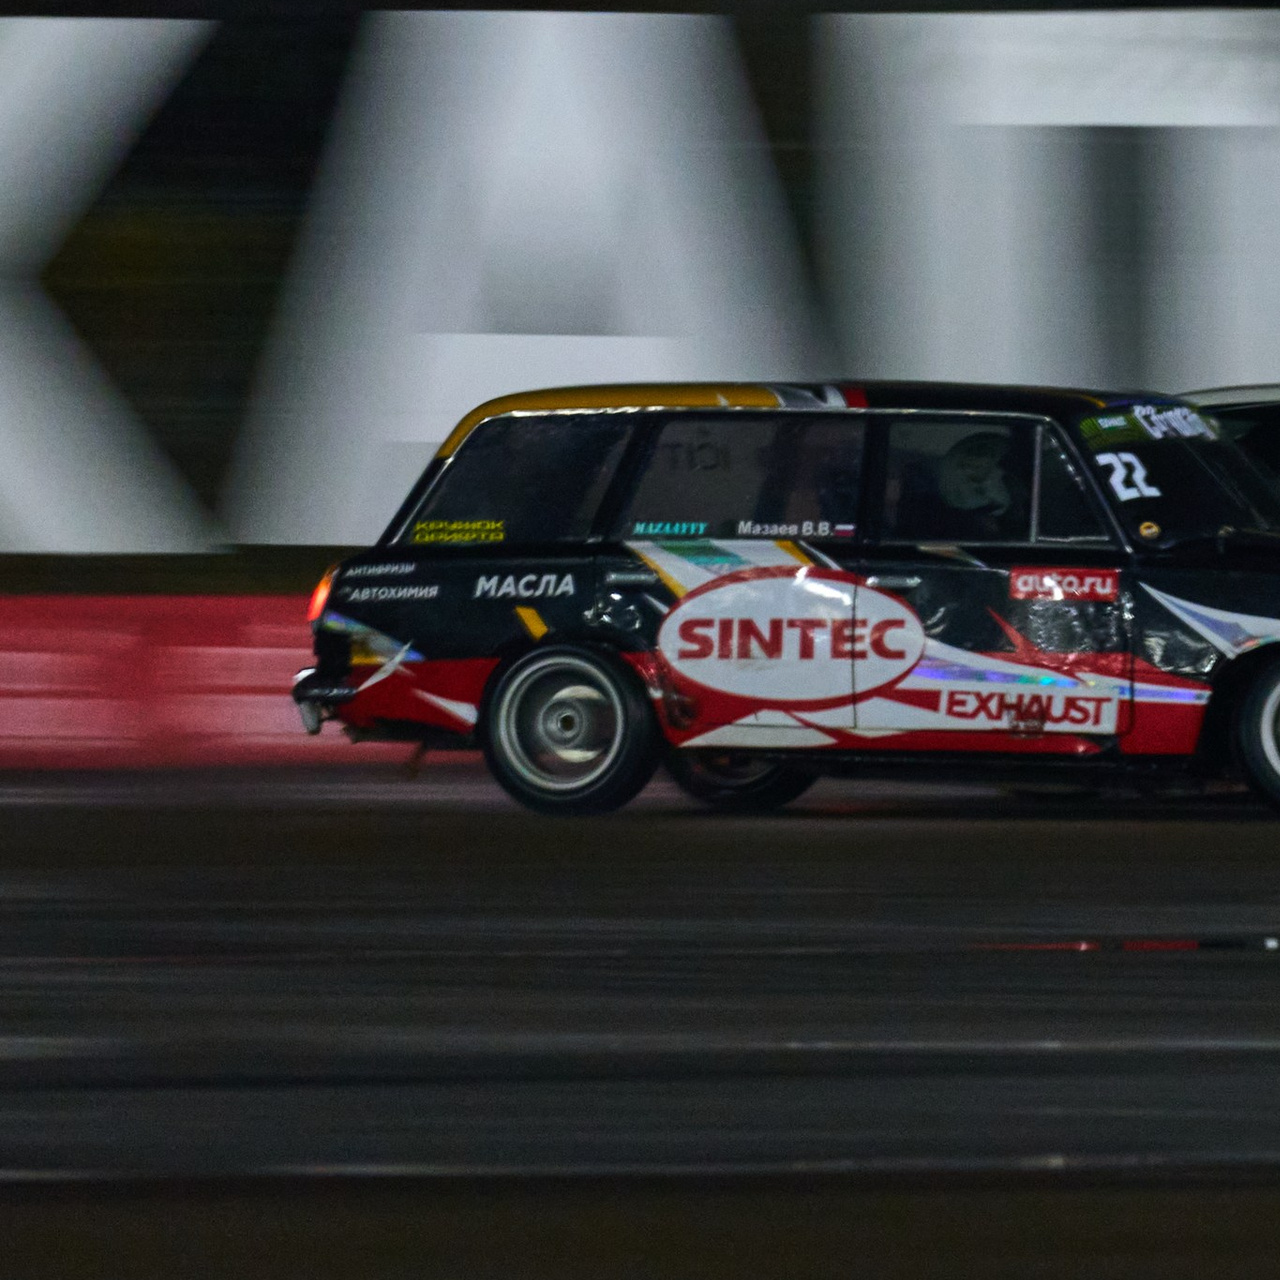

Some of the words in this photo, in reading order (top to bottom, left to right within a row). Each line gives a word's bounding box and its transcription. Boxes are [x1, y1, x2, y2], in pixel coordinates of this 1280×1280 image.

[1095, 452, 1161, 501] 22
[738, 521, 798, 535] Мазаев
[349, 586, 439, 602] АВТОХИМИЯ
[474, 573, 576, 598] МАСЛА
[1017, 574, 1113, 595] auto.ru
[678, 618, 906, 659] SINTEC
[946, 690, 1112, 725] EXHAUST
